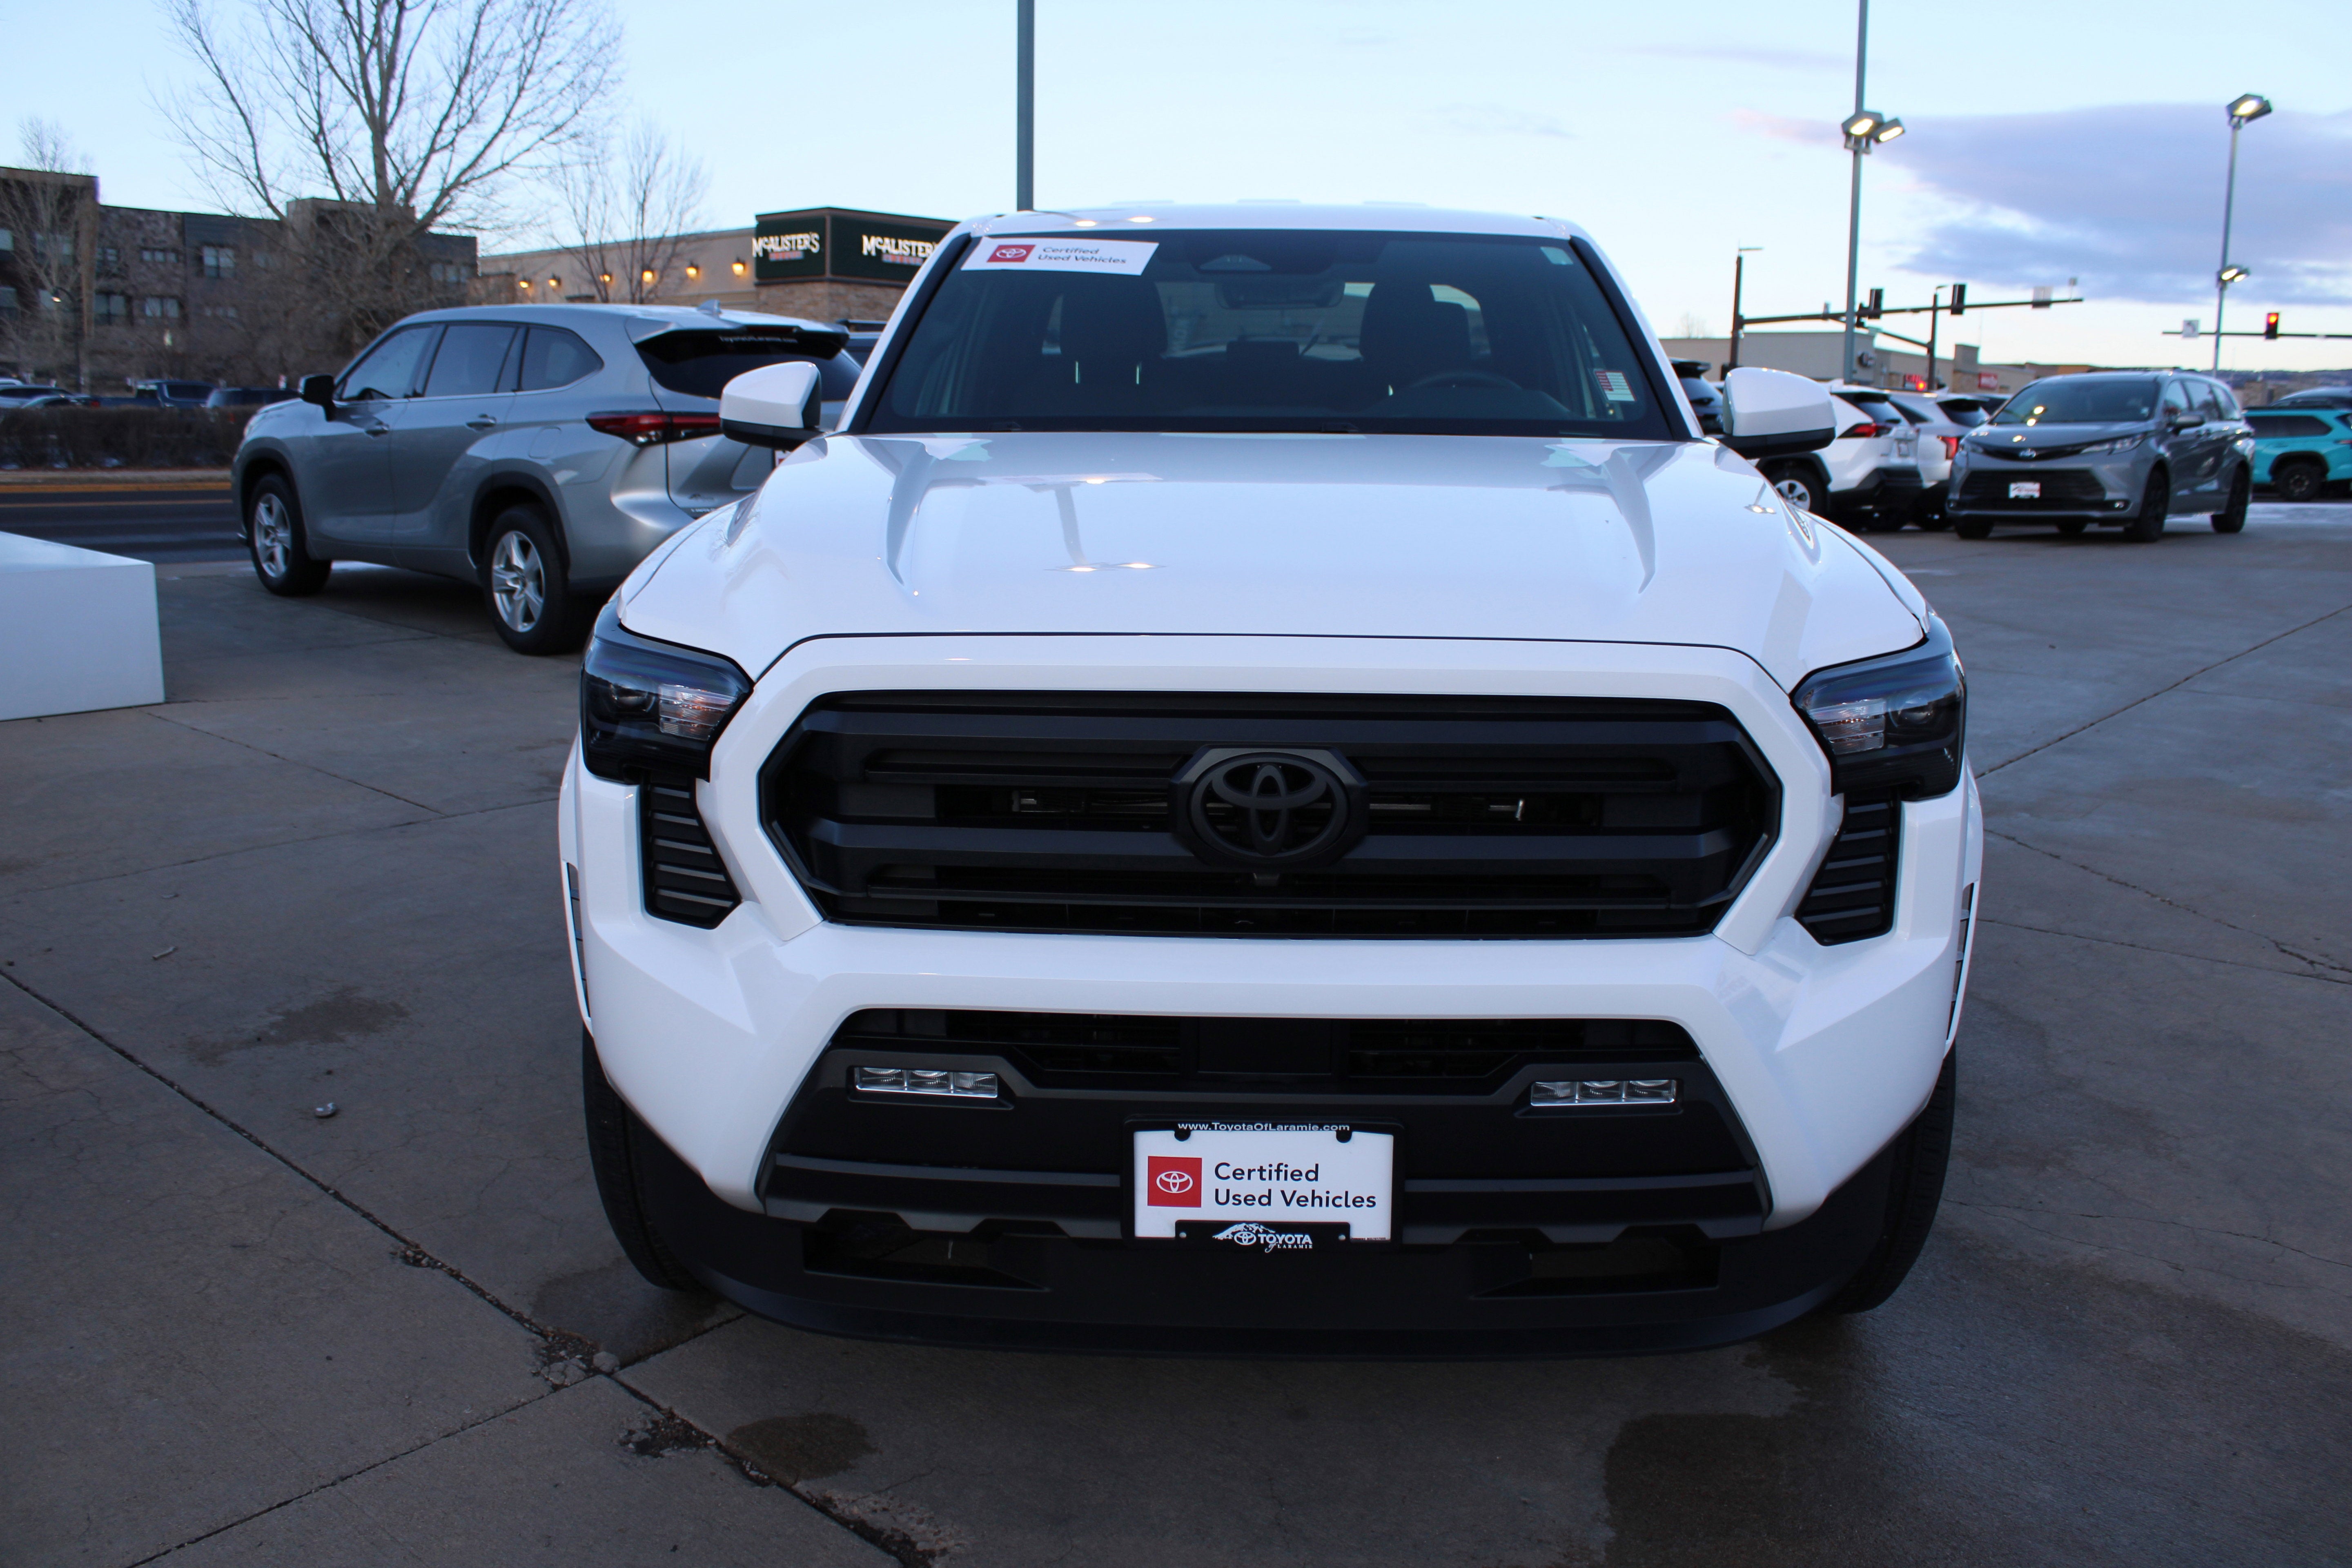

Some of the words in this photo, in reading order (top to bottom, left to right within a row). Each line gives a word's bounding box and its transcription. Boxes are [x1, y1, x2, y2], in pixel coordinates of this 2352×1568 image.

[1075, 255, 1126, 264] Vehicles
[1178, 1123, 1350, 1131] www.ToyotaOfLaramie.com
[1214, 1162, 1319, 1182] Certified
[1215, 1188, 1272, 1206] Used
[1280, 1189, 1376, 1208] Vehicles
[1258, 1234, 1313, 1245] TOYOTA
[1265, 1242, 1278, 1253] of
